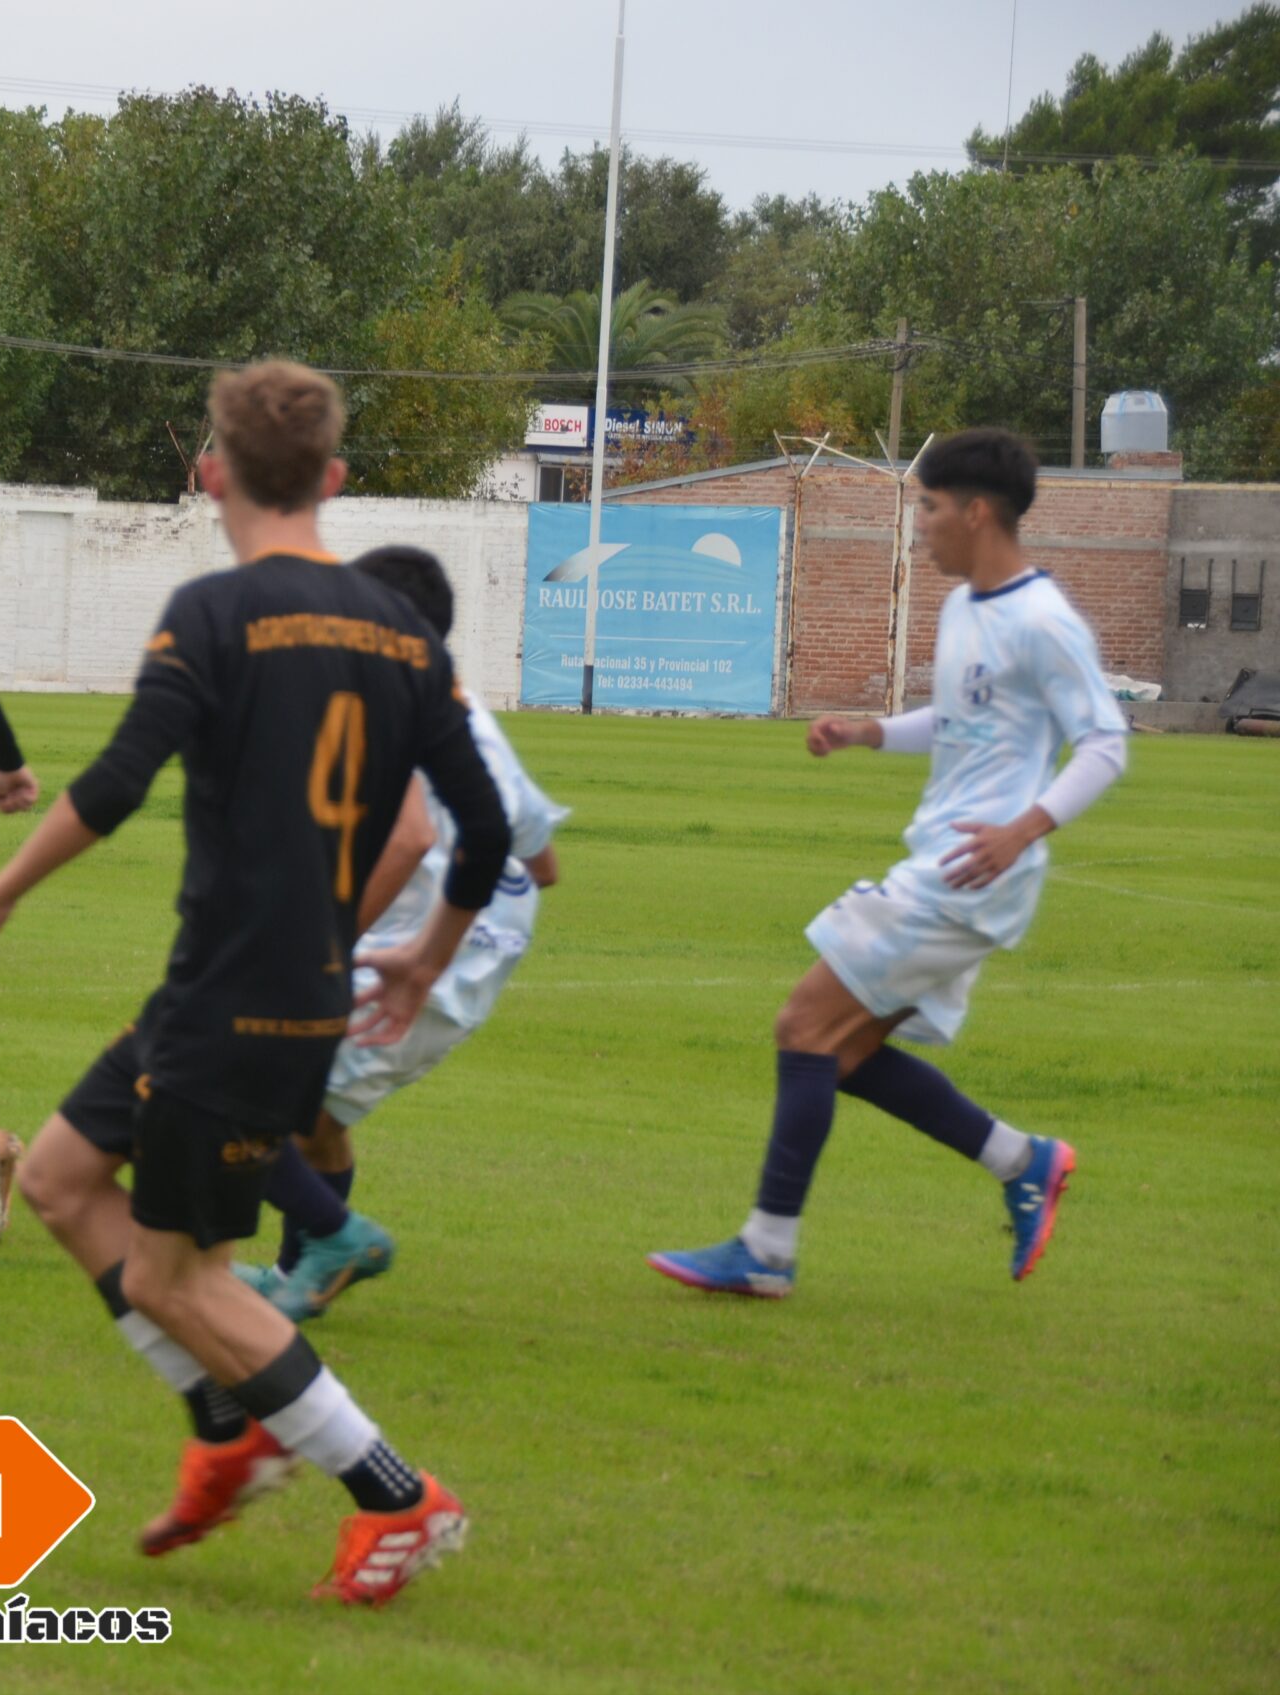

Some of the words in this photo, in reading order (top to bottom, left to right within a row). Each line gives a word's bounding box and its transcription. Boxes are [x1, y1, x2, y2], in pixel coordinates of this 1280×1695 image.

[544, 418, 582, 433] BOSCH
[538, 587, 587, 609] RAUL
[642, 590, 706, 613] BATET
[710, 592, 762, 614] S.R.L.
[584, 656, 631, 670] acional
[634, 657, 647, 671] 35
[649, 662, 655, 673] y
[658, 658, 709, 673] Provincial
[713, 660, 732, 673] 102
[598, 674, 614, 688] Tel:
[308, 690, 368, 900] 4
